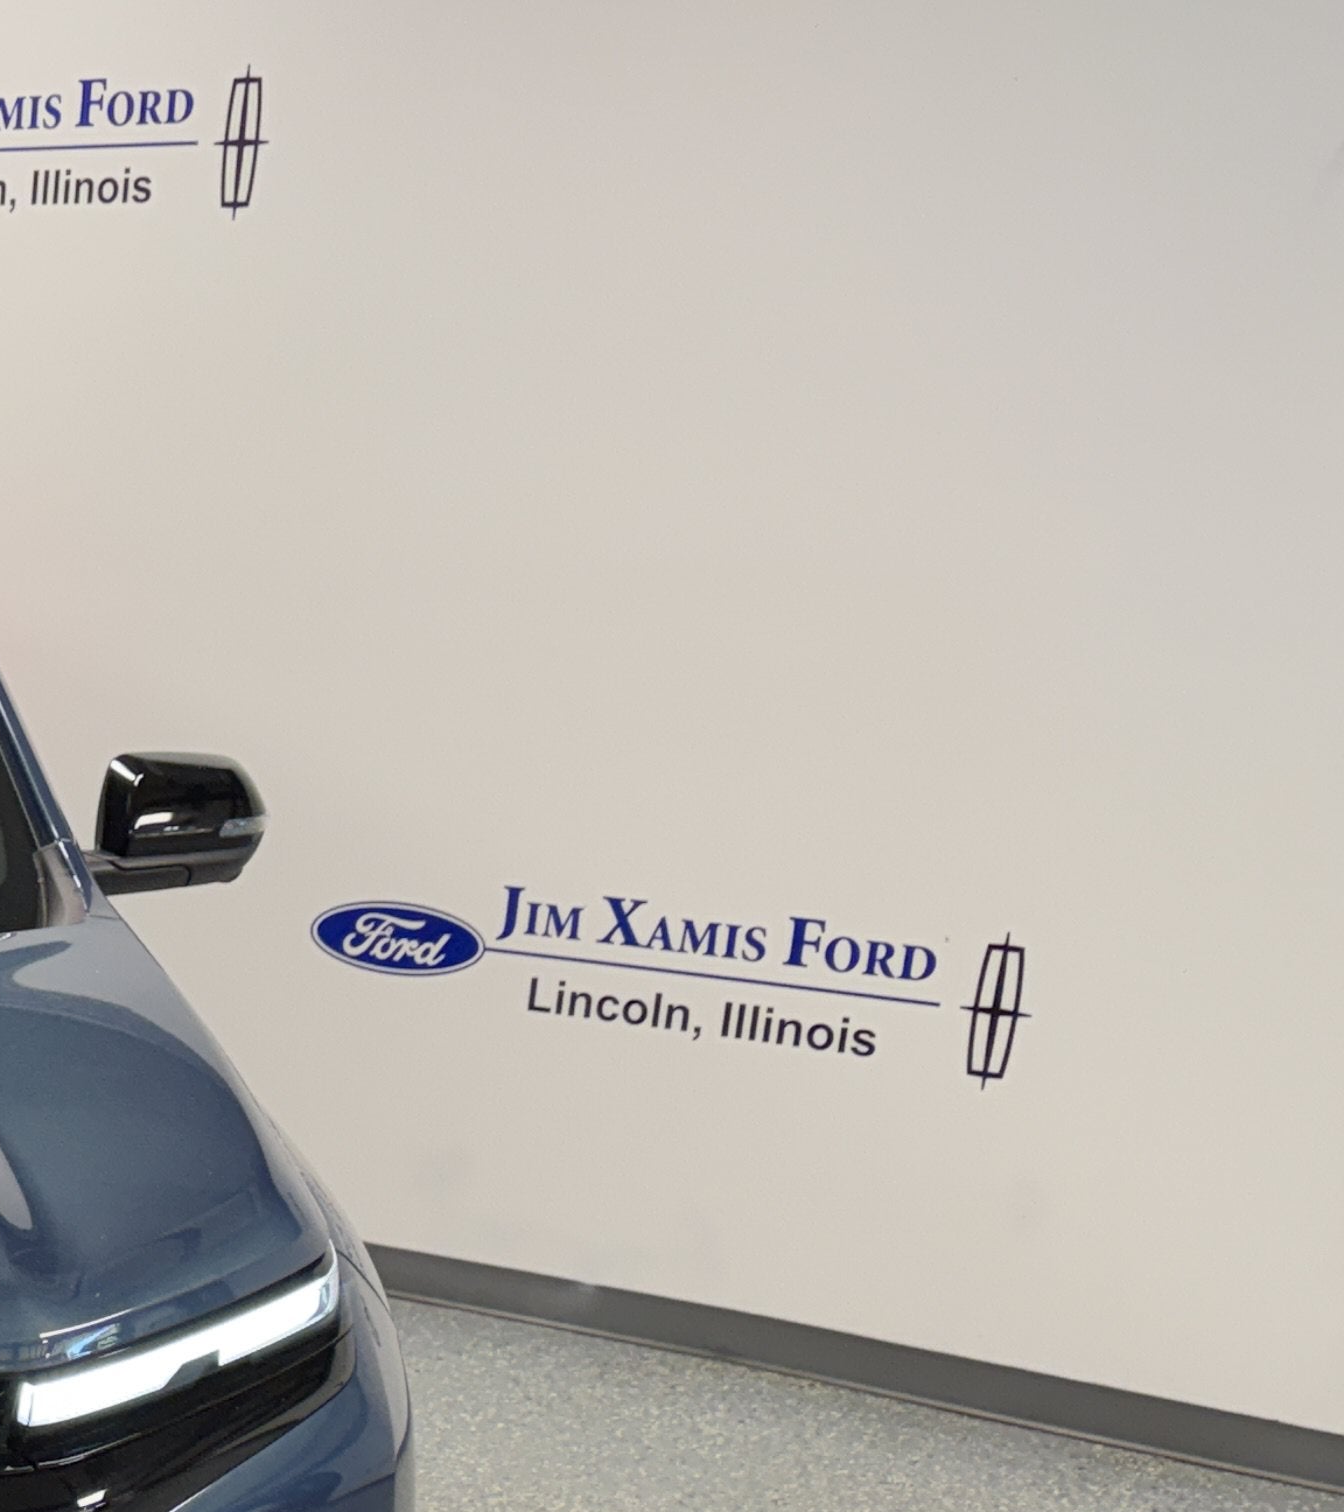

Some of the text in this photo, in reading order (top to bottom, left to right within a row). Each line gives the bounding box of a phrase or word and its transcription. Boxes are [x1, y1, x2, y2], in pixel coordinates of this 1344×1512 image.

[75, 78, 195, 129] FORD
[30, 167, 152, 206] Illinois
[341, 911, 448, 967] Ford
[496, 885, 938, 982] JIM XAMIS FORD
[526, 976, 878, 1057] Lincoln, Illinois
